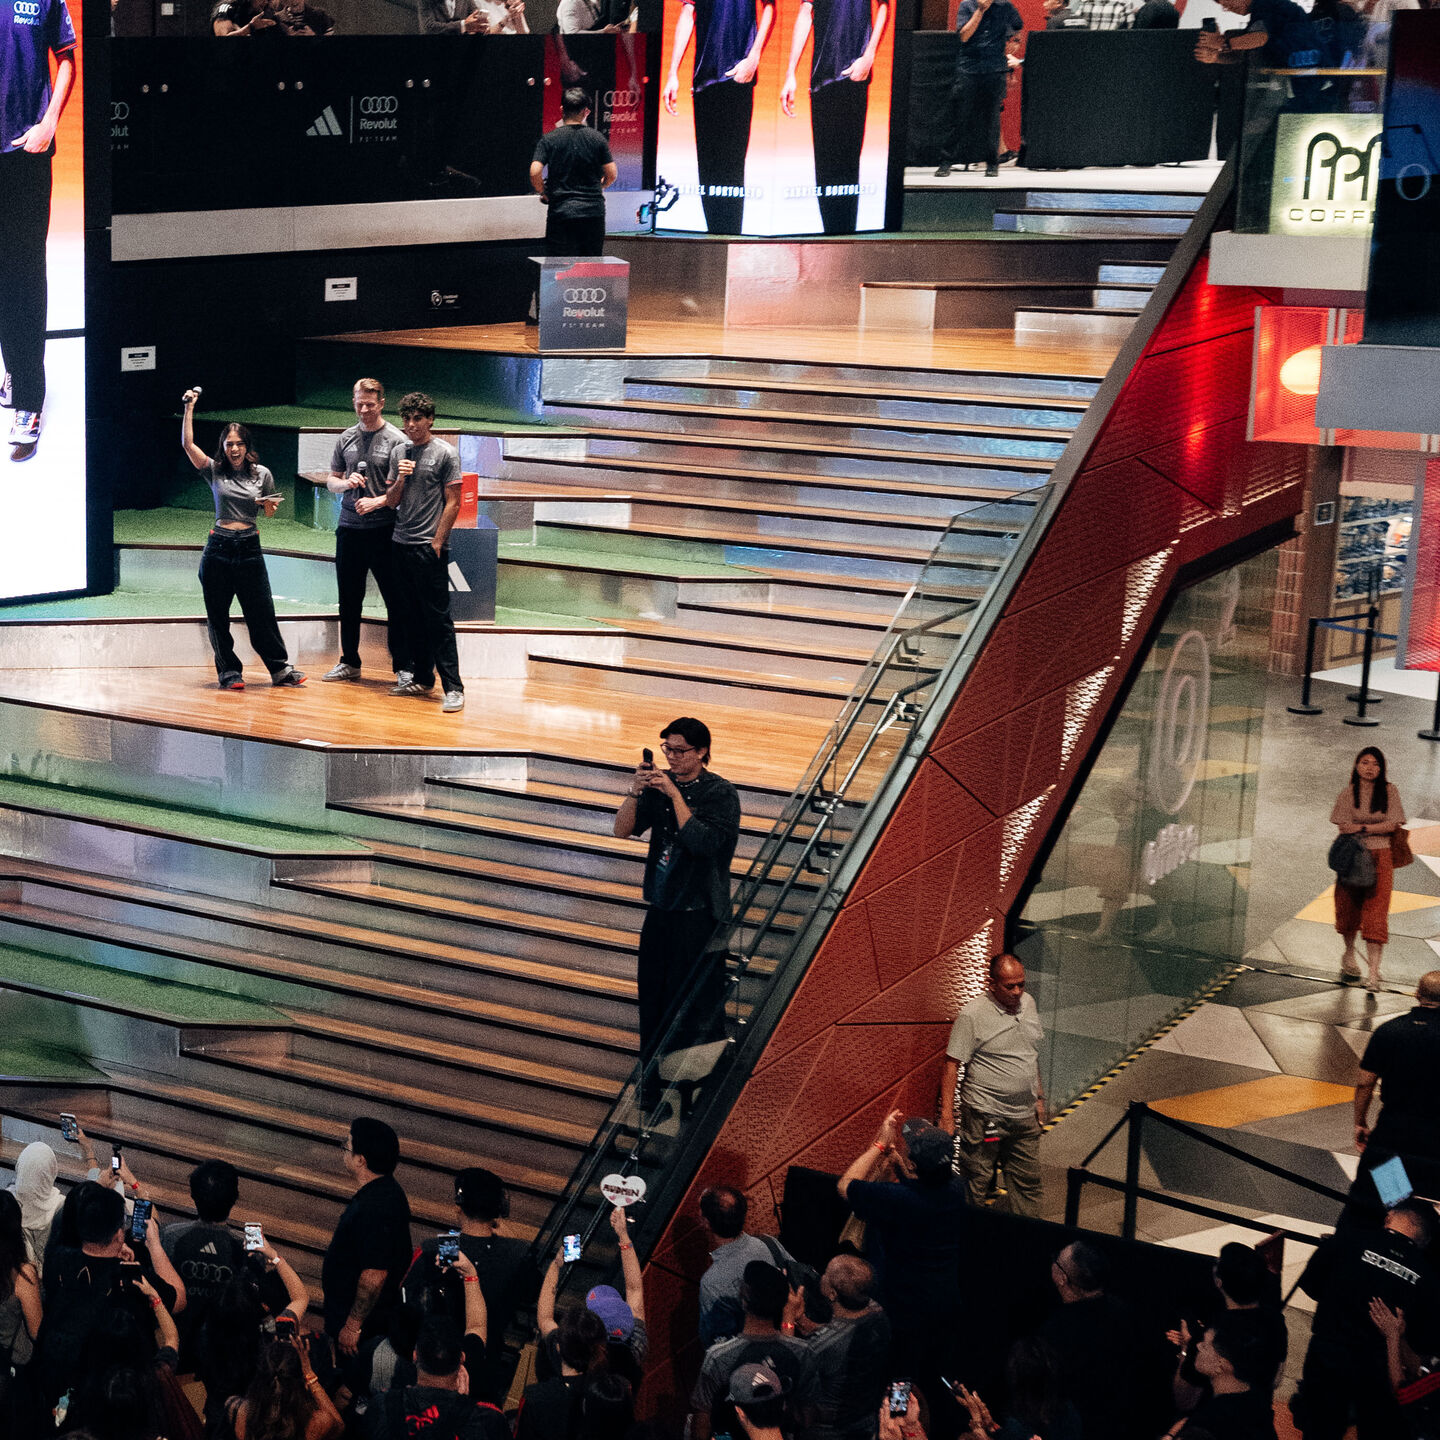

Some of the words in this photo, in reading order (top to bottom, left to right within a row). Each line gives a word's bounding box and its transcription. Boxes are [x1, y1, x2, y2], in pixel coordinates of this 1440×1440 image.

[602, 111, 638, 123] Revolut
[360, 117, 398, 131] Revolut
[562, 306, 605, 318] Revolut
[1361, 1248, 1421, 1286] SECURITY
